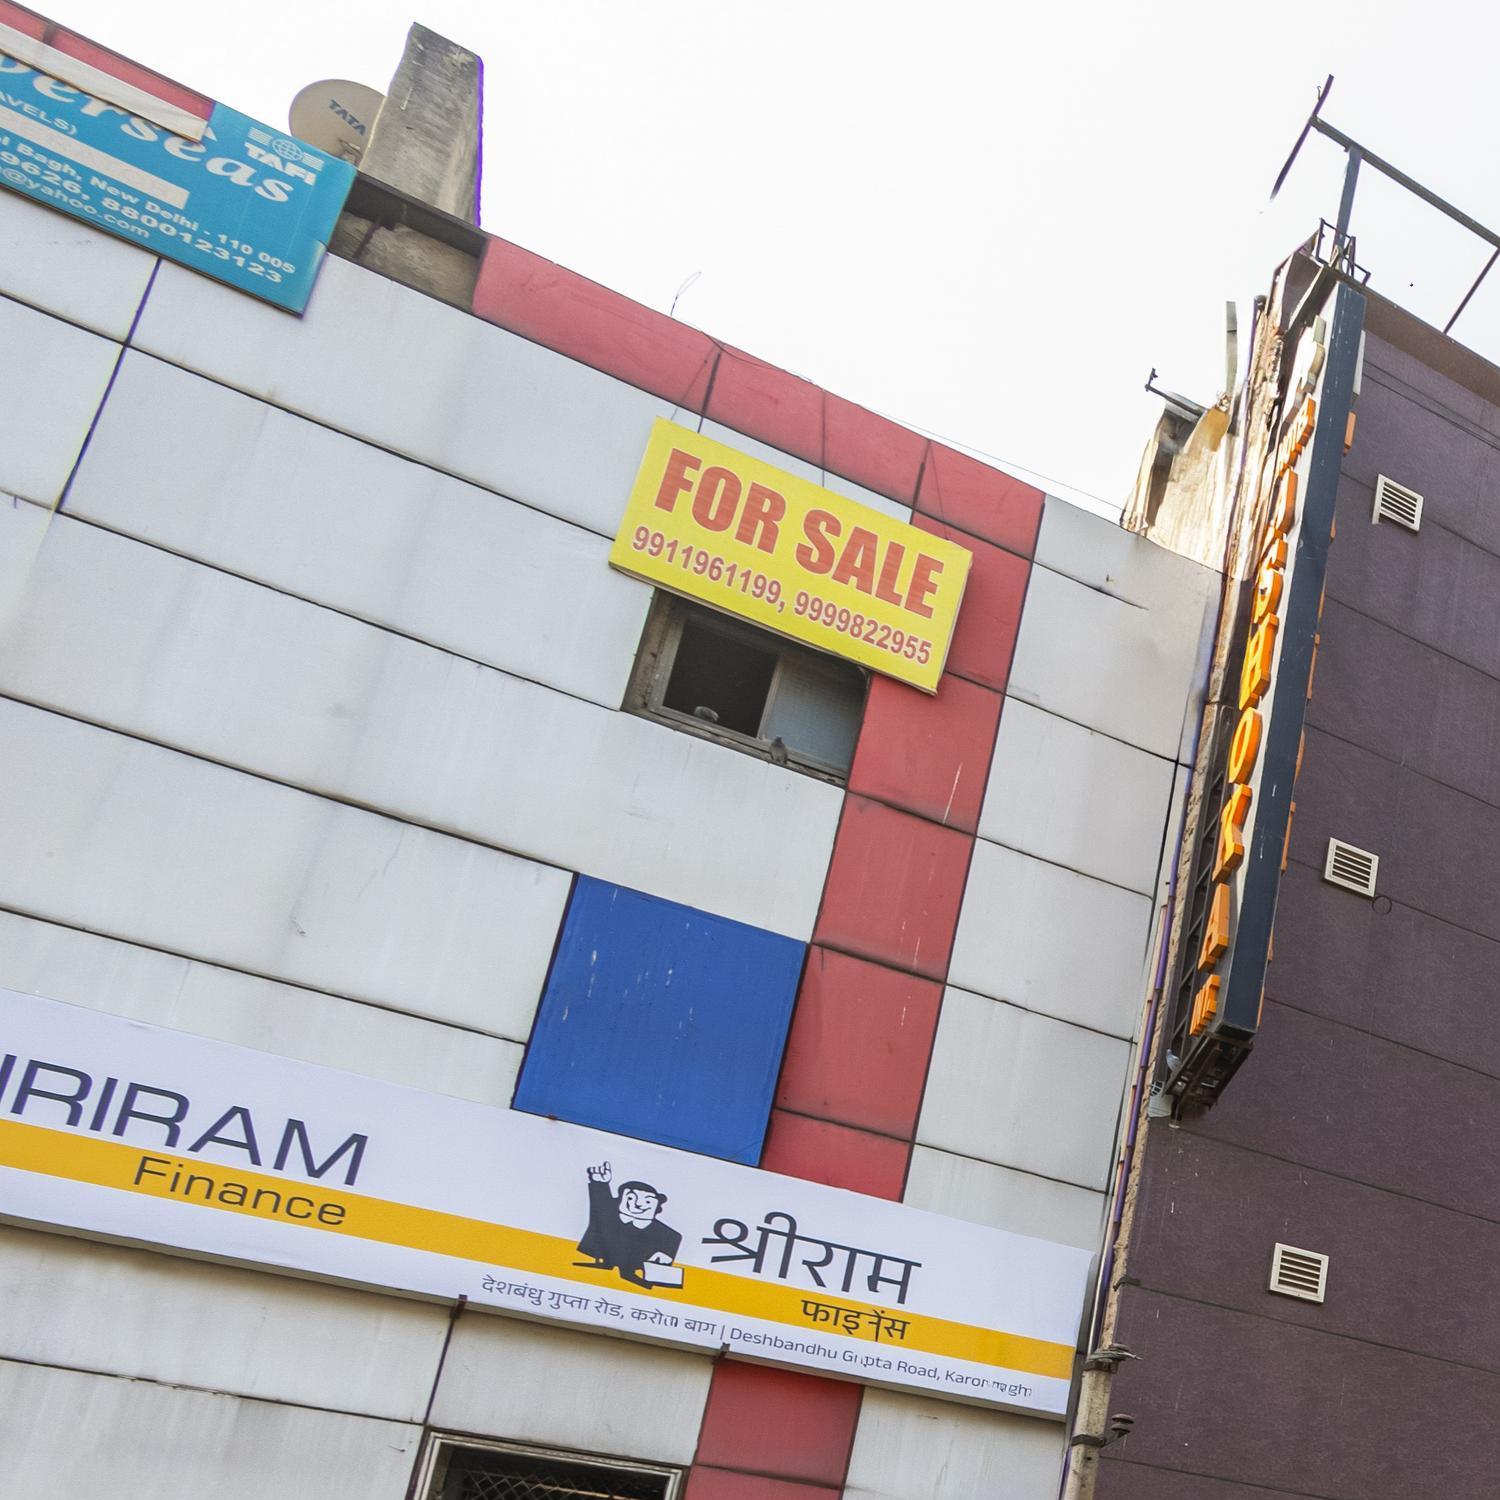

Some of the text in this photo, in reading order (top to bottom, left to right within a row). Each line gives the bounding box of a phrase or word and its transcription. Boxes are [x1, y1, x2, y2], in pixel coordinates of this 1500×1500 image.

[328, 98, 367, 137] TATA
[243, 141, 318, 186] TAFI
[16, 142, 83, 182] Bagh,
[90, 176, 141, 204] New
[145, 201, 200, 232] Delhi
[217, 233, 254, 255] 110
[258, 251, 296, 274] 005
[101, 197, 283, 284] 8800123123
[654, 446, 946, 620] FOR SALE
[632, 524, 934, 667] 9911961199, 9999822955
[133, 1154, 348, 1227] Finance
[700, 1211, 923, 1305] श्रीराम
[481, 1274, 544, 1306] देशबंधु
[547, 1290, 591, 1310] गुप्ता
[592, 1296, 626, 1321] रोड,
[684, 1316, 717, 1336] बाग
[730, 1326, 838, 1360] Deshbandhu
[896, 1359, 941, 1381] Road,
